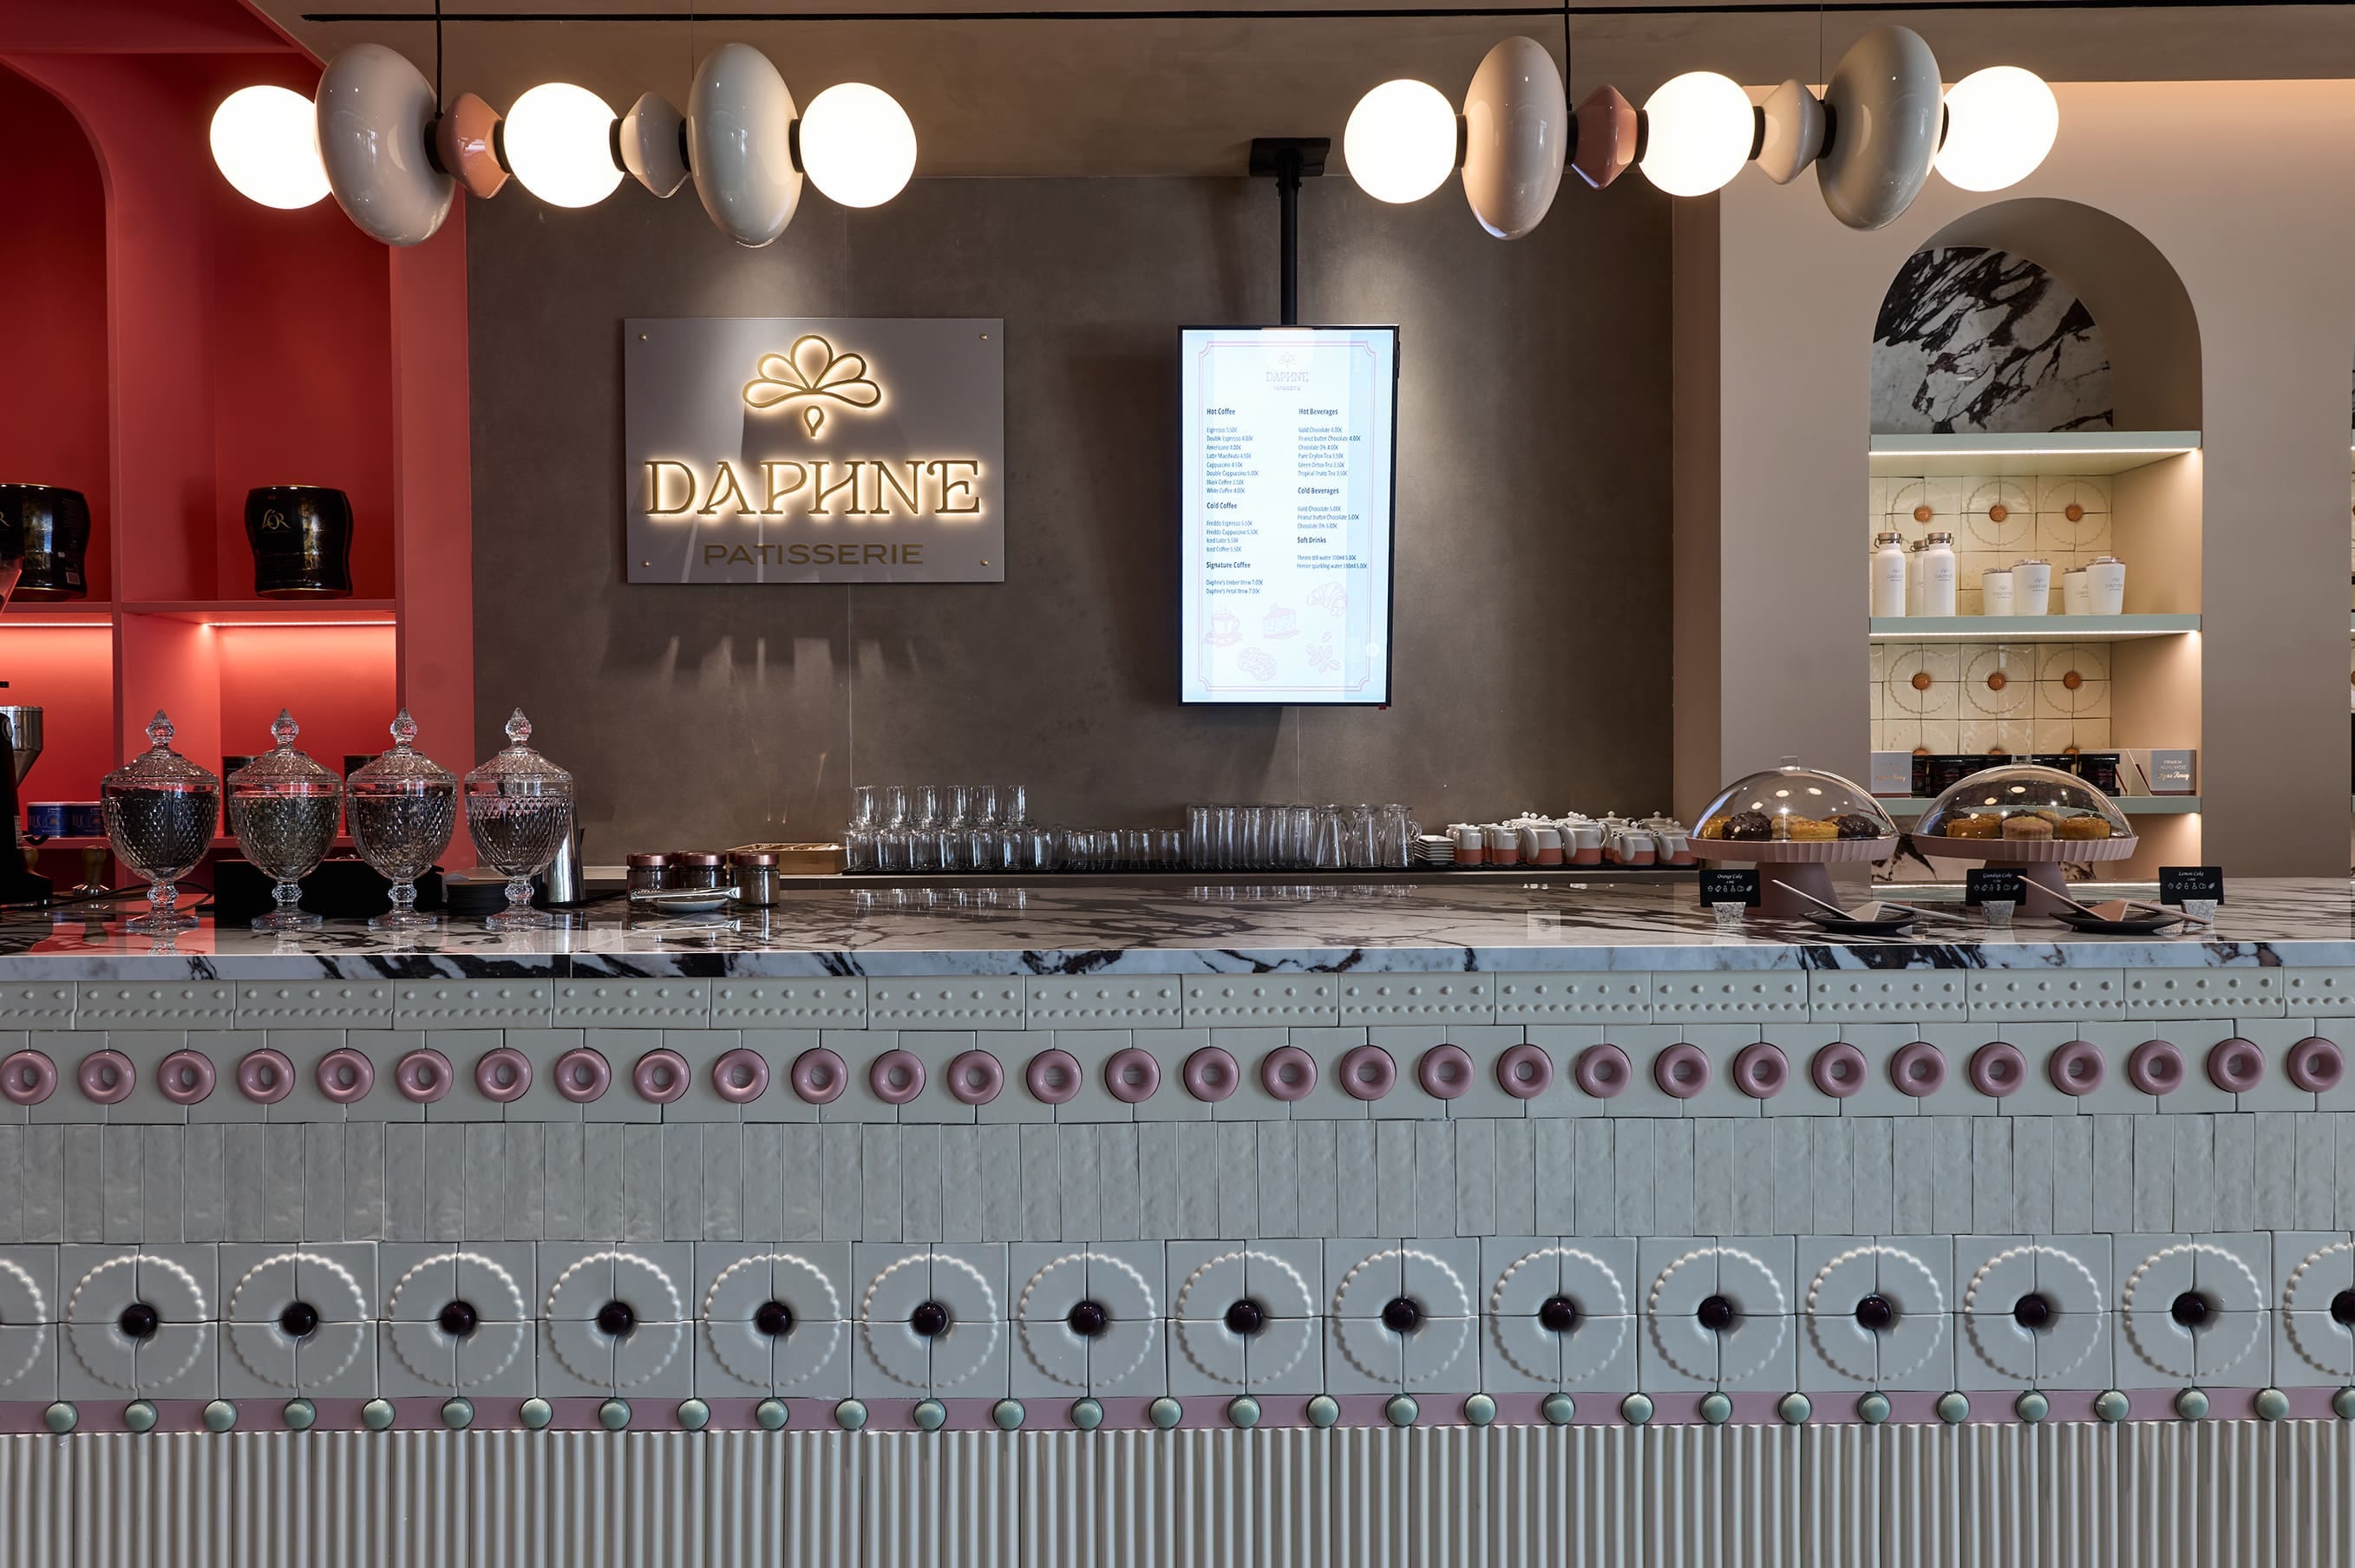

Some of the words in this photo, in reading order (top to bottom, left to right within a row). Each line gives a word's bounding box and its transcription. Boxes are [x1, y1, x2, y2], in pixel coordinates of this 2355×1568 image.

[1266, 372, 1309, 382] DAPHNE
[644, 461, 980, 514] DAPHNE
[703, 544, 923, 565] PATISSERIE
